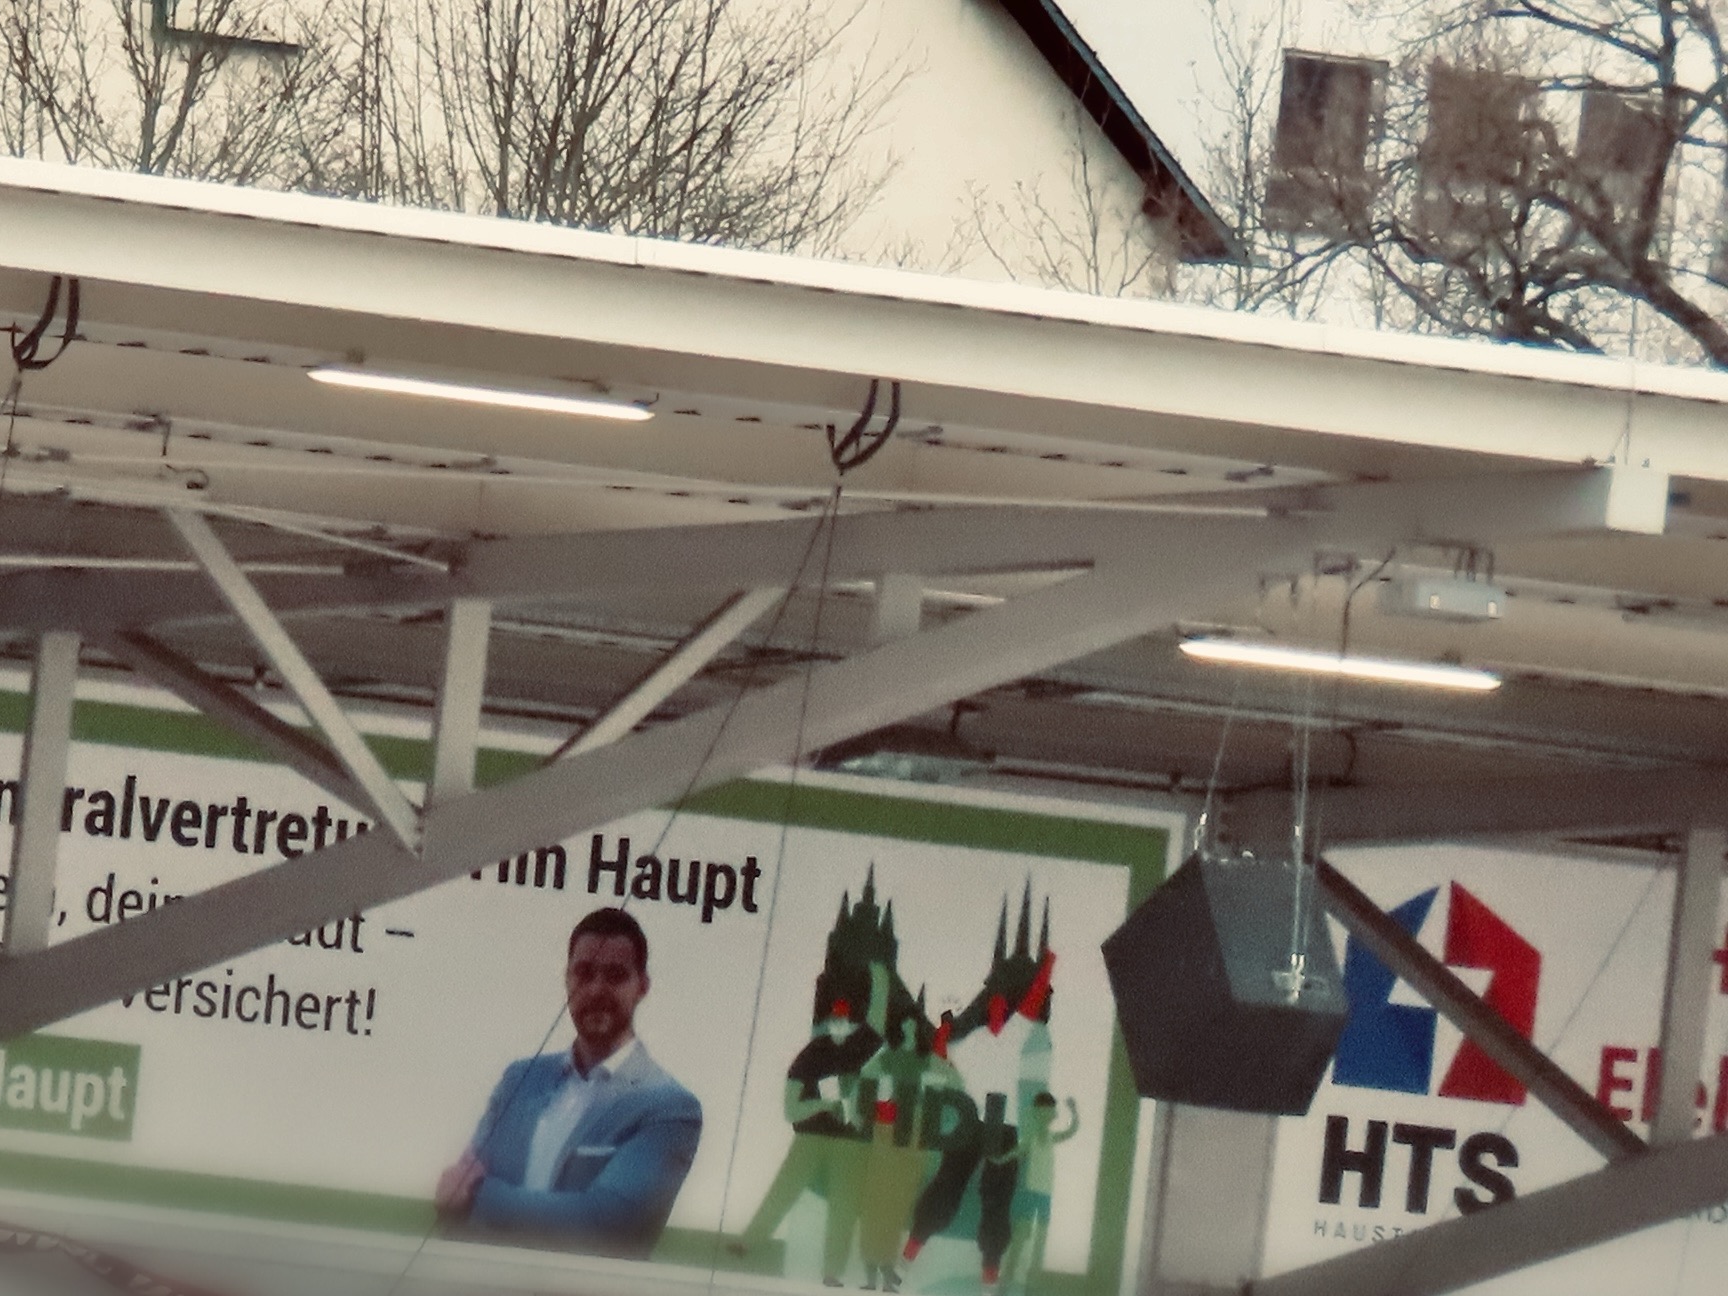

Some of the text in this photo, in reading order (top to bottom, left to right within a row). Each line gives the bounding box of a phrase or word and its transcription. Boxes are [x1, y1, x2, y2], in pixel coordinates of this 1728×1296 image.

[470, 844, 566, 890] im
[587, 834, 761, 924] Haupt
[1319, 1114, 1520, 1216] HTS
